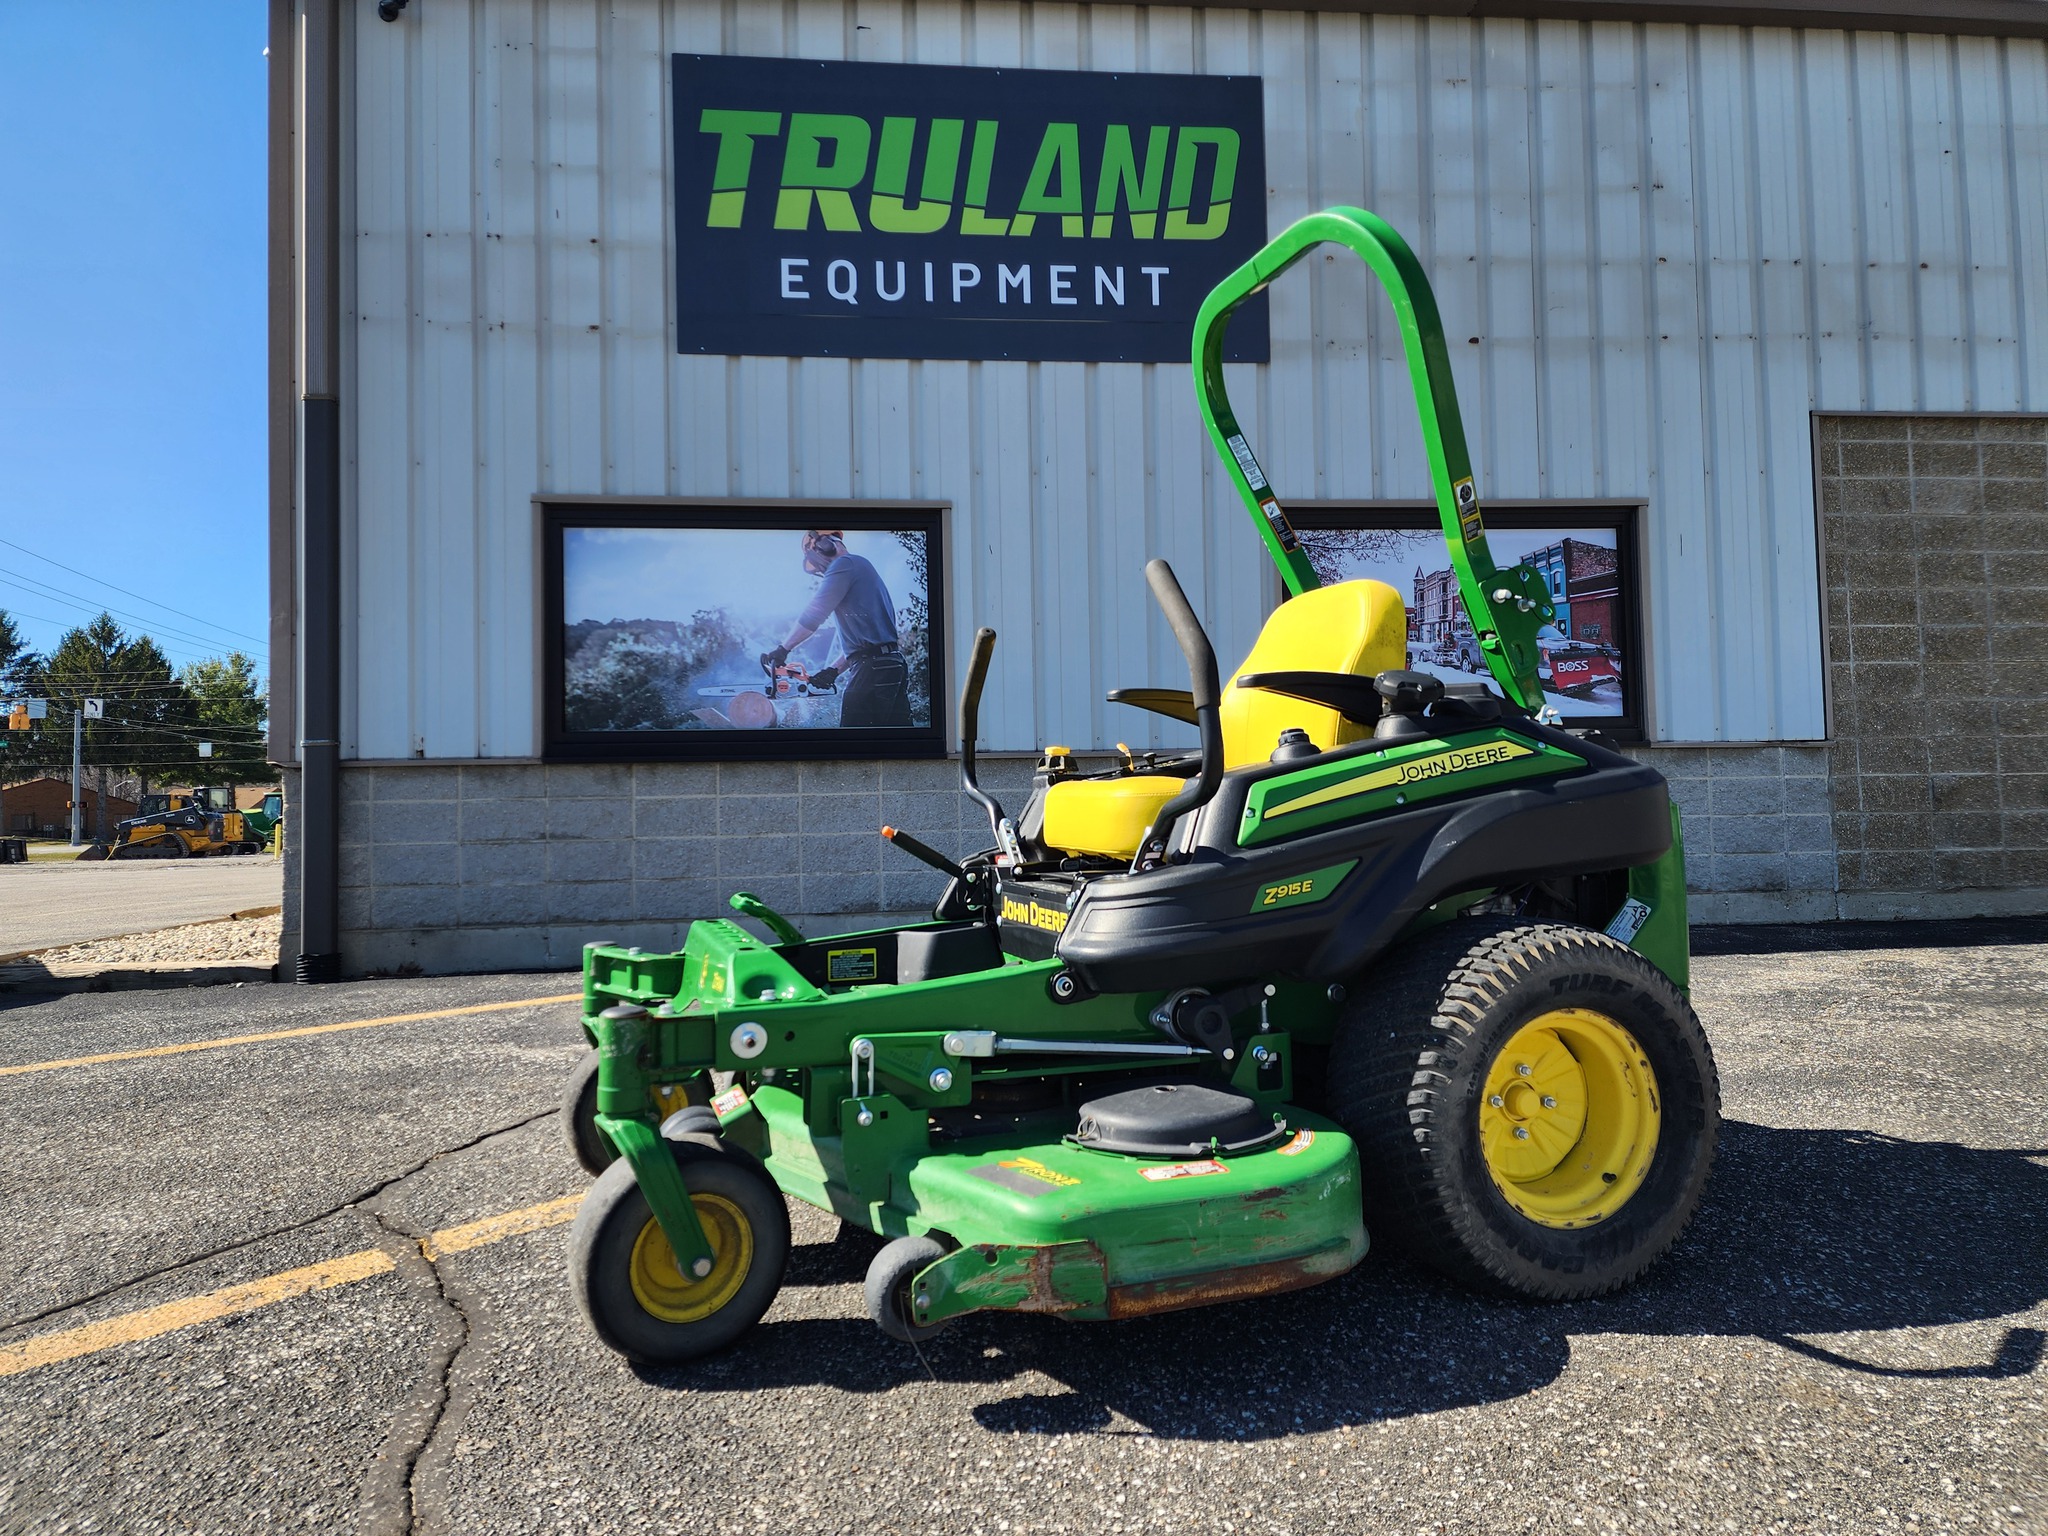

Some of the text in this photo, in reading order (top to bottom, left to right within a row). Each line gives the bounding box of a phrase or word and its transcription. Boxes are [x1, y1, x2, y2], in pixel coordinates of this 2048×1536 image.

[699, 108, 1241, 240] TRULAND
[780, 257, 1171, 306] EQUIPMENT
[1557, 660, 1589, 673] BOSS
[1397, 746, 1511, 784] JOHN DEERE
[1263, 879, 1313, 905] Z915E
[1001, 896, 1029, 924] JOHN
[1549, 973, 1633, 996] TURF
